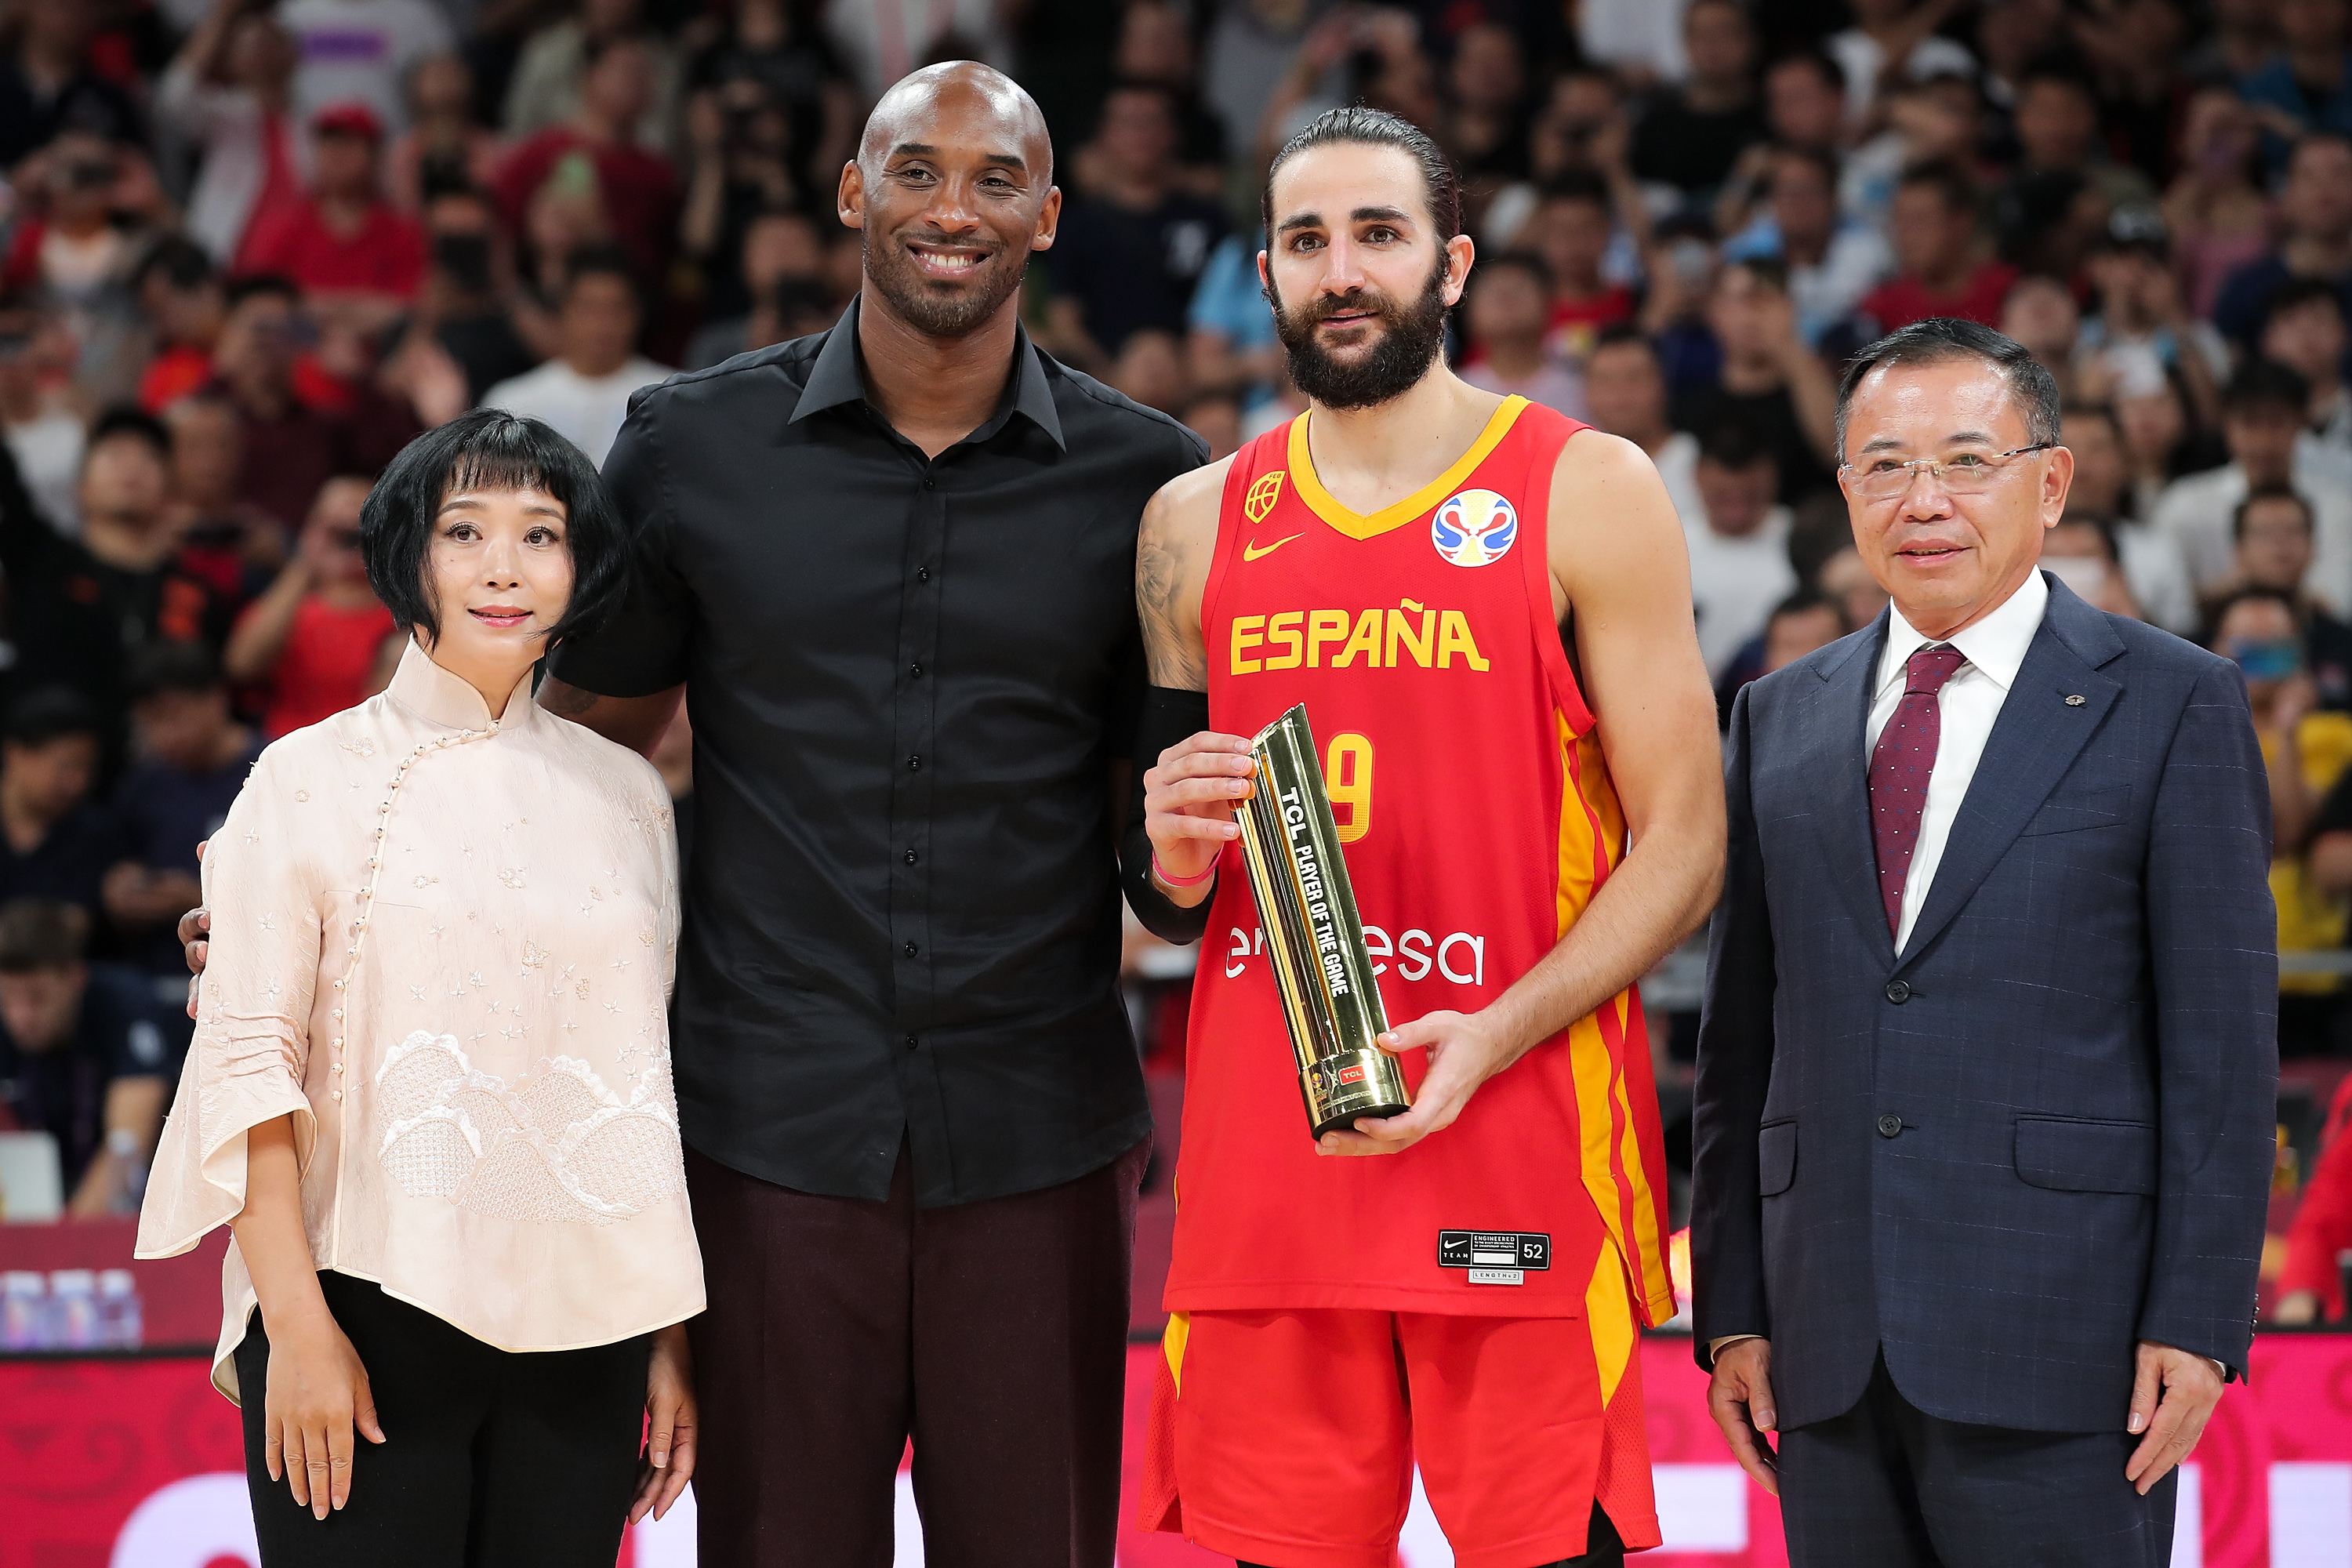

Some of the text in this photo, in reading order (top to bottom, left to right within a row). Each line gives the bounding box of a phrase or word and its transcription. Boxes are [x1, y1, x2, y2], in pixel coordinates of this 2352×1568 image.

[1230, 597, 1490, 676] ESPAÑA
[1327, 733, 1373, 843] 9
[1281, 786, 1349, 998] TCL PLAYER OF THE GAME
[1225, 925, 1485, 986] eesa
[1343, 1070, 1363, 1079] TCL
[1523, 1243, 1543, 1259] 52
